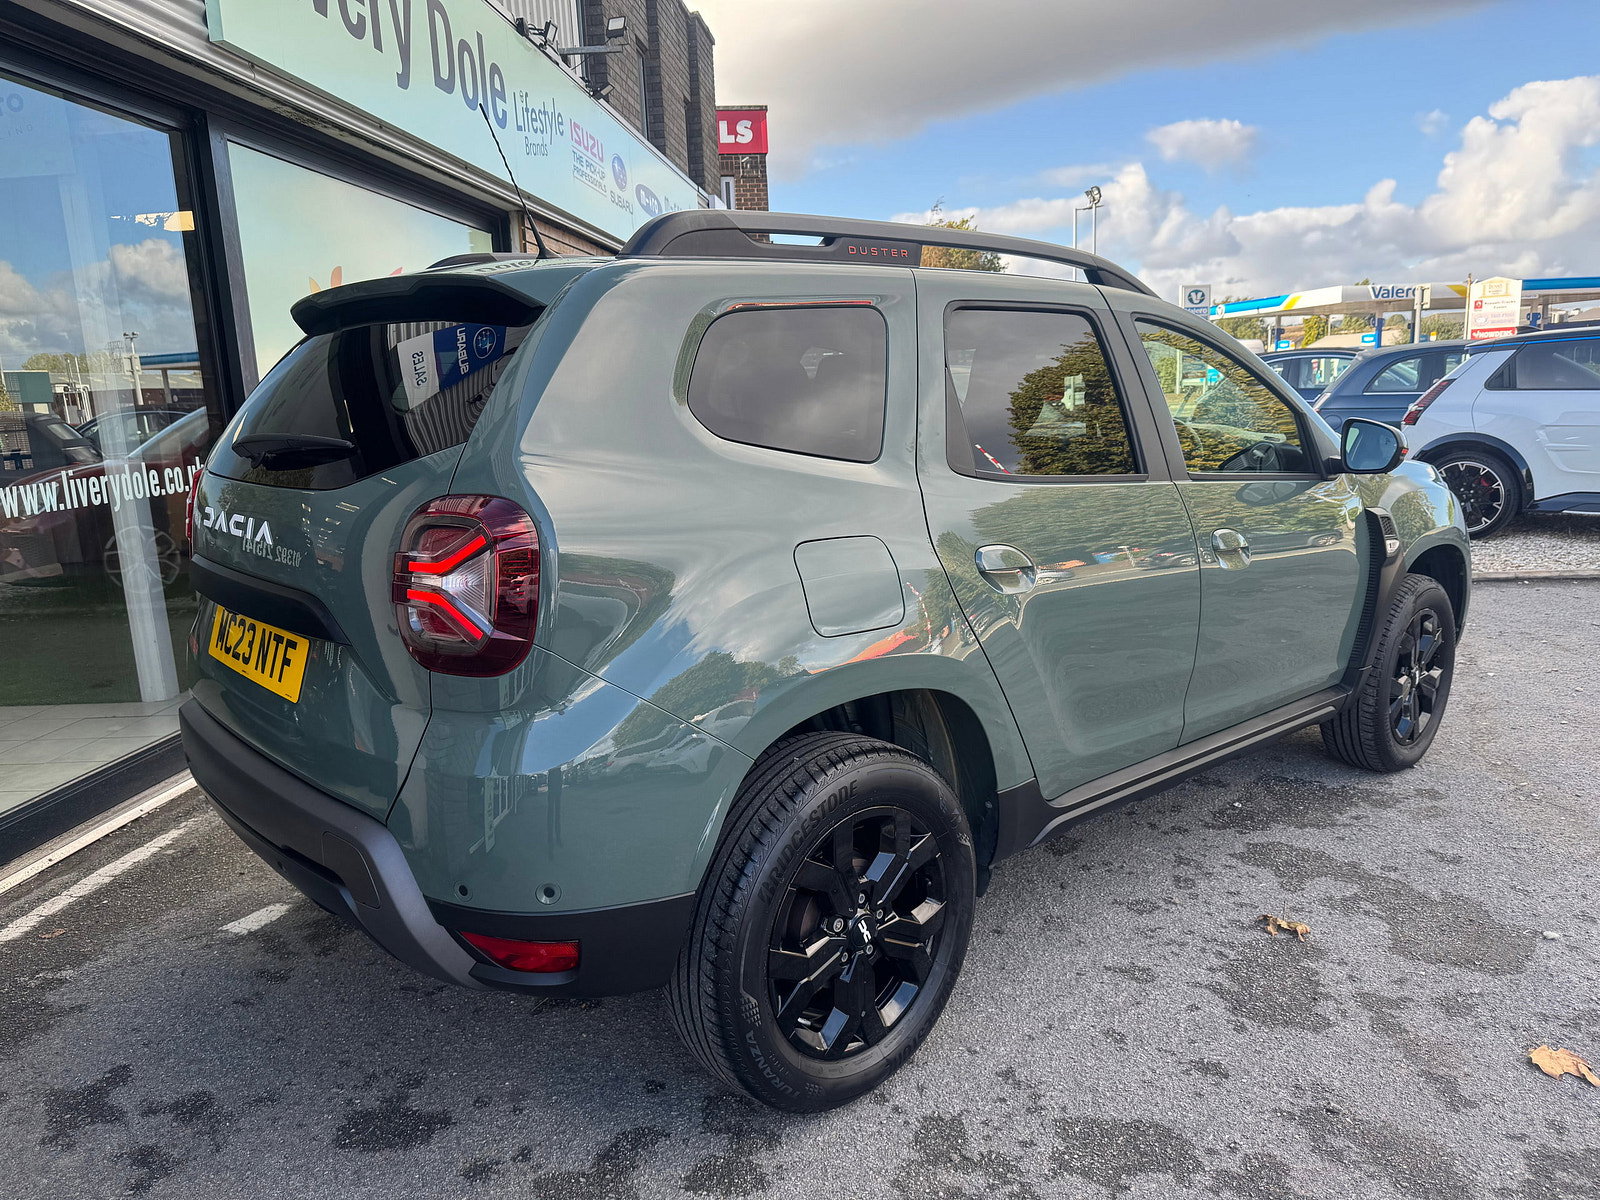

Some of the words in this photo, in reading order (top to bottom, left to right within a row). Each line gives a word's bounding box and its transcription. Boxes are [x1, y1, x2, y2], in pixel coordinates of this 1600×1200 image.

[427, 0, 507, 129] Dole
[513, 90, 564, 145] Lifestyle
[719, 119, 754, 144] LS
[525, 136, 548, 157] Brands
[570, 118, 605, 163] ISUZU
[572, 150, 586, 168] THE
[610, 190, 634, 215] SUBARU
[848, 246, 909, 257] DUSTER
[203, 506, 273, 545] DACIA
[254, 628, 298, 683] NTF
